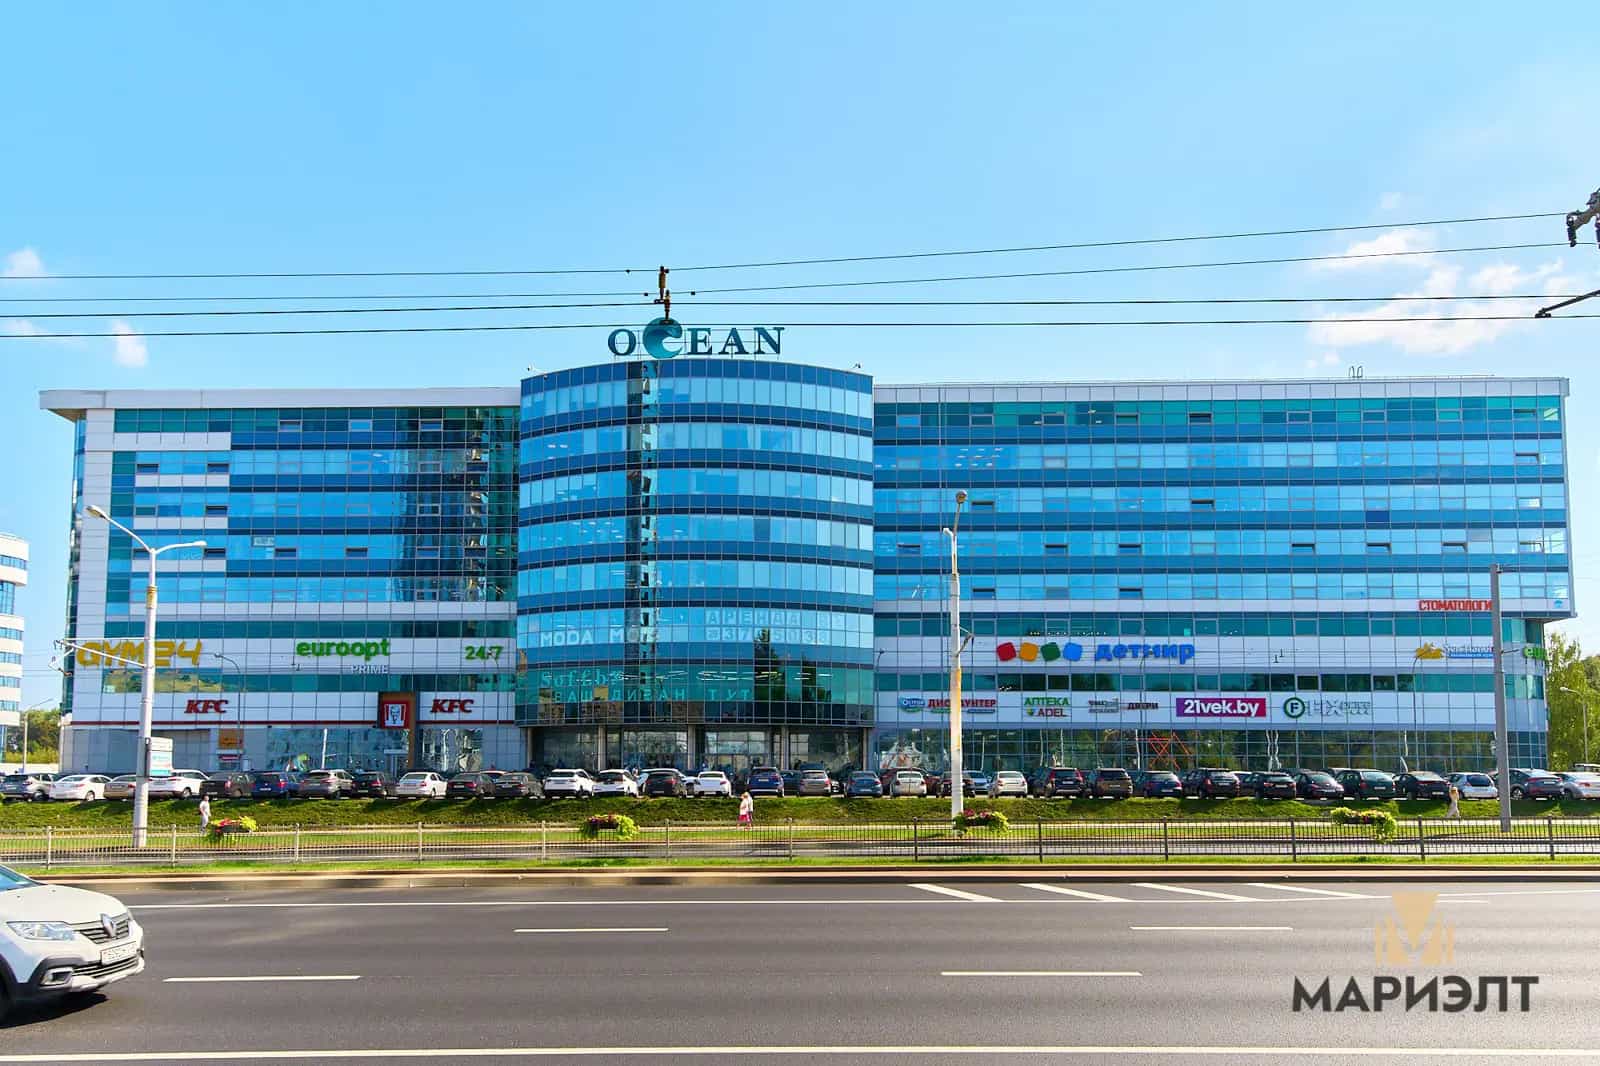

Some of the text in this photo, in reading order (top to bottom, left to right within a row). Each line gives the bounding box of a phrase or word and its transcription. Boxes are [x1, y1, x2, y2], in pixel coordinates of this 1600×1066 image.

[607, 317, 785, 359] OCEAN
[1419, 600, 1493, 611] СТОМАТОЛОГИ
[76, 640, 203, 667] GYM24
[296, 638, 390, 661] euroopt
[350, 664, 389, 674] PRIME
[184, 700, 229, 714] KFC
[430, 699, 474, 713] KFC
[927, 698, 996, 708] ДИСУНТЕР
[1024, 697, 1070, 706] АПТЕКА
[1183, 699, 1260, 717] 21vek.by
